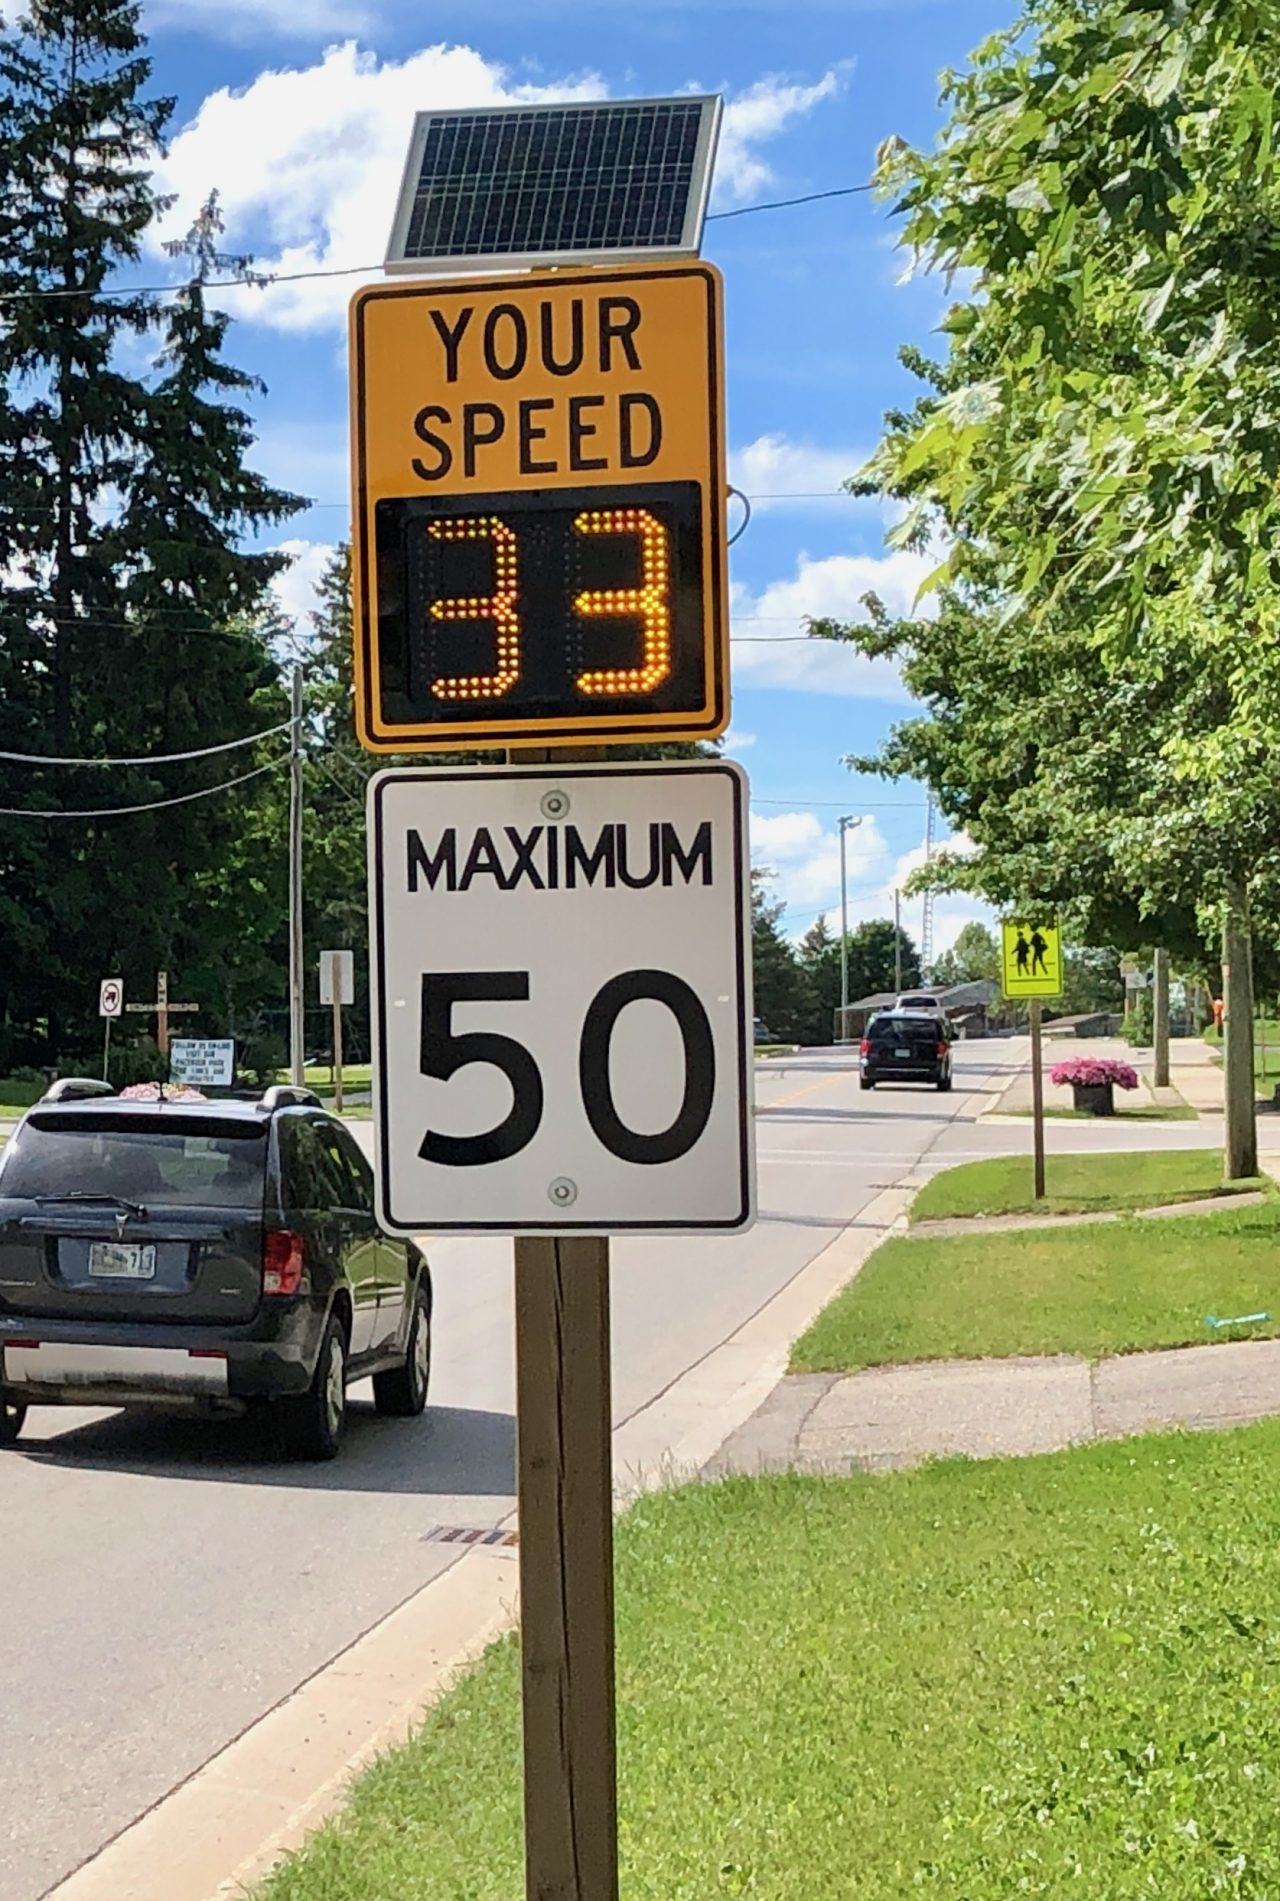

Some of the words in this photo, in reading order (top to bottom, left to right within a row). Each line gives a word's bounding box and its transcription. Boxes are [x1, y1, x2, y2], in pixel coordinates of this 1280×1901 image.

[427, 295, 643, 383] YOUR
[410, 392, 663, 481] SPEED
[427, 508, 671, 699] 33
[406, 821, 713, 892] MAXIMUM
[417, 968, 716, 1167] 50
